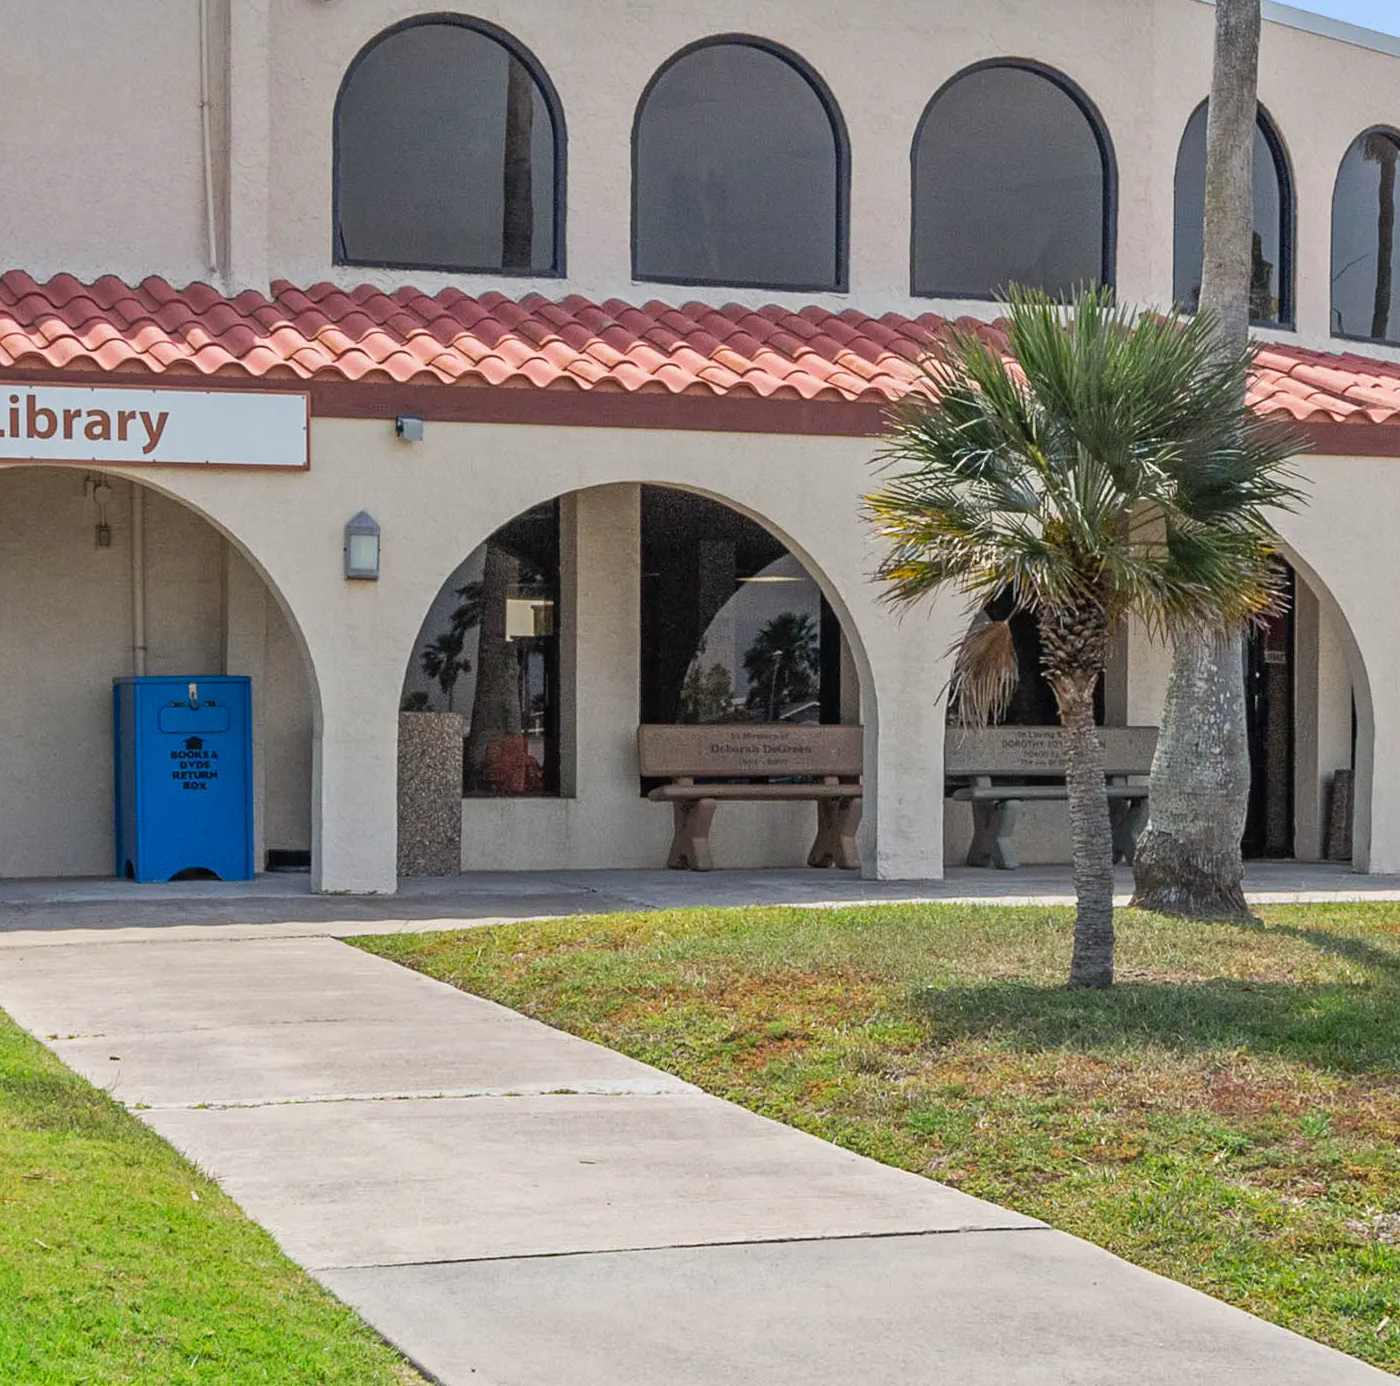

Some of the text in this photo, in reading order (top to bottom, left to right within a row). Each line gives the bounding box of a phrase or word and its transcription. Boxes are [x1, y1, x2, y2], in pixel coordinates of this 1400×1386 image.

[0, 394, 169, 455] ibrary
[711, 743, 759, 754] Deborah
[1002, 740, 1045, 748] DOROTHY
[170, 750, 218, 759] BOOKS &
[172, 771, 218, 780] RETURN
[182, 781, 207, 790] BOX
